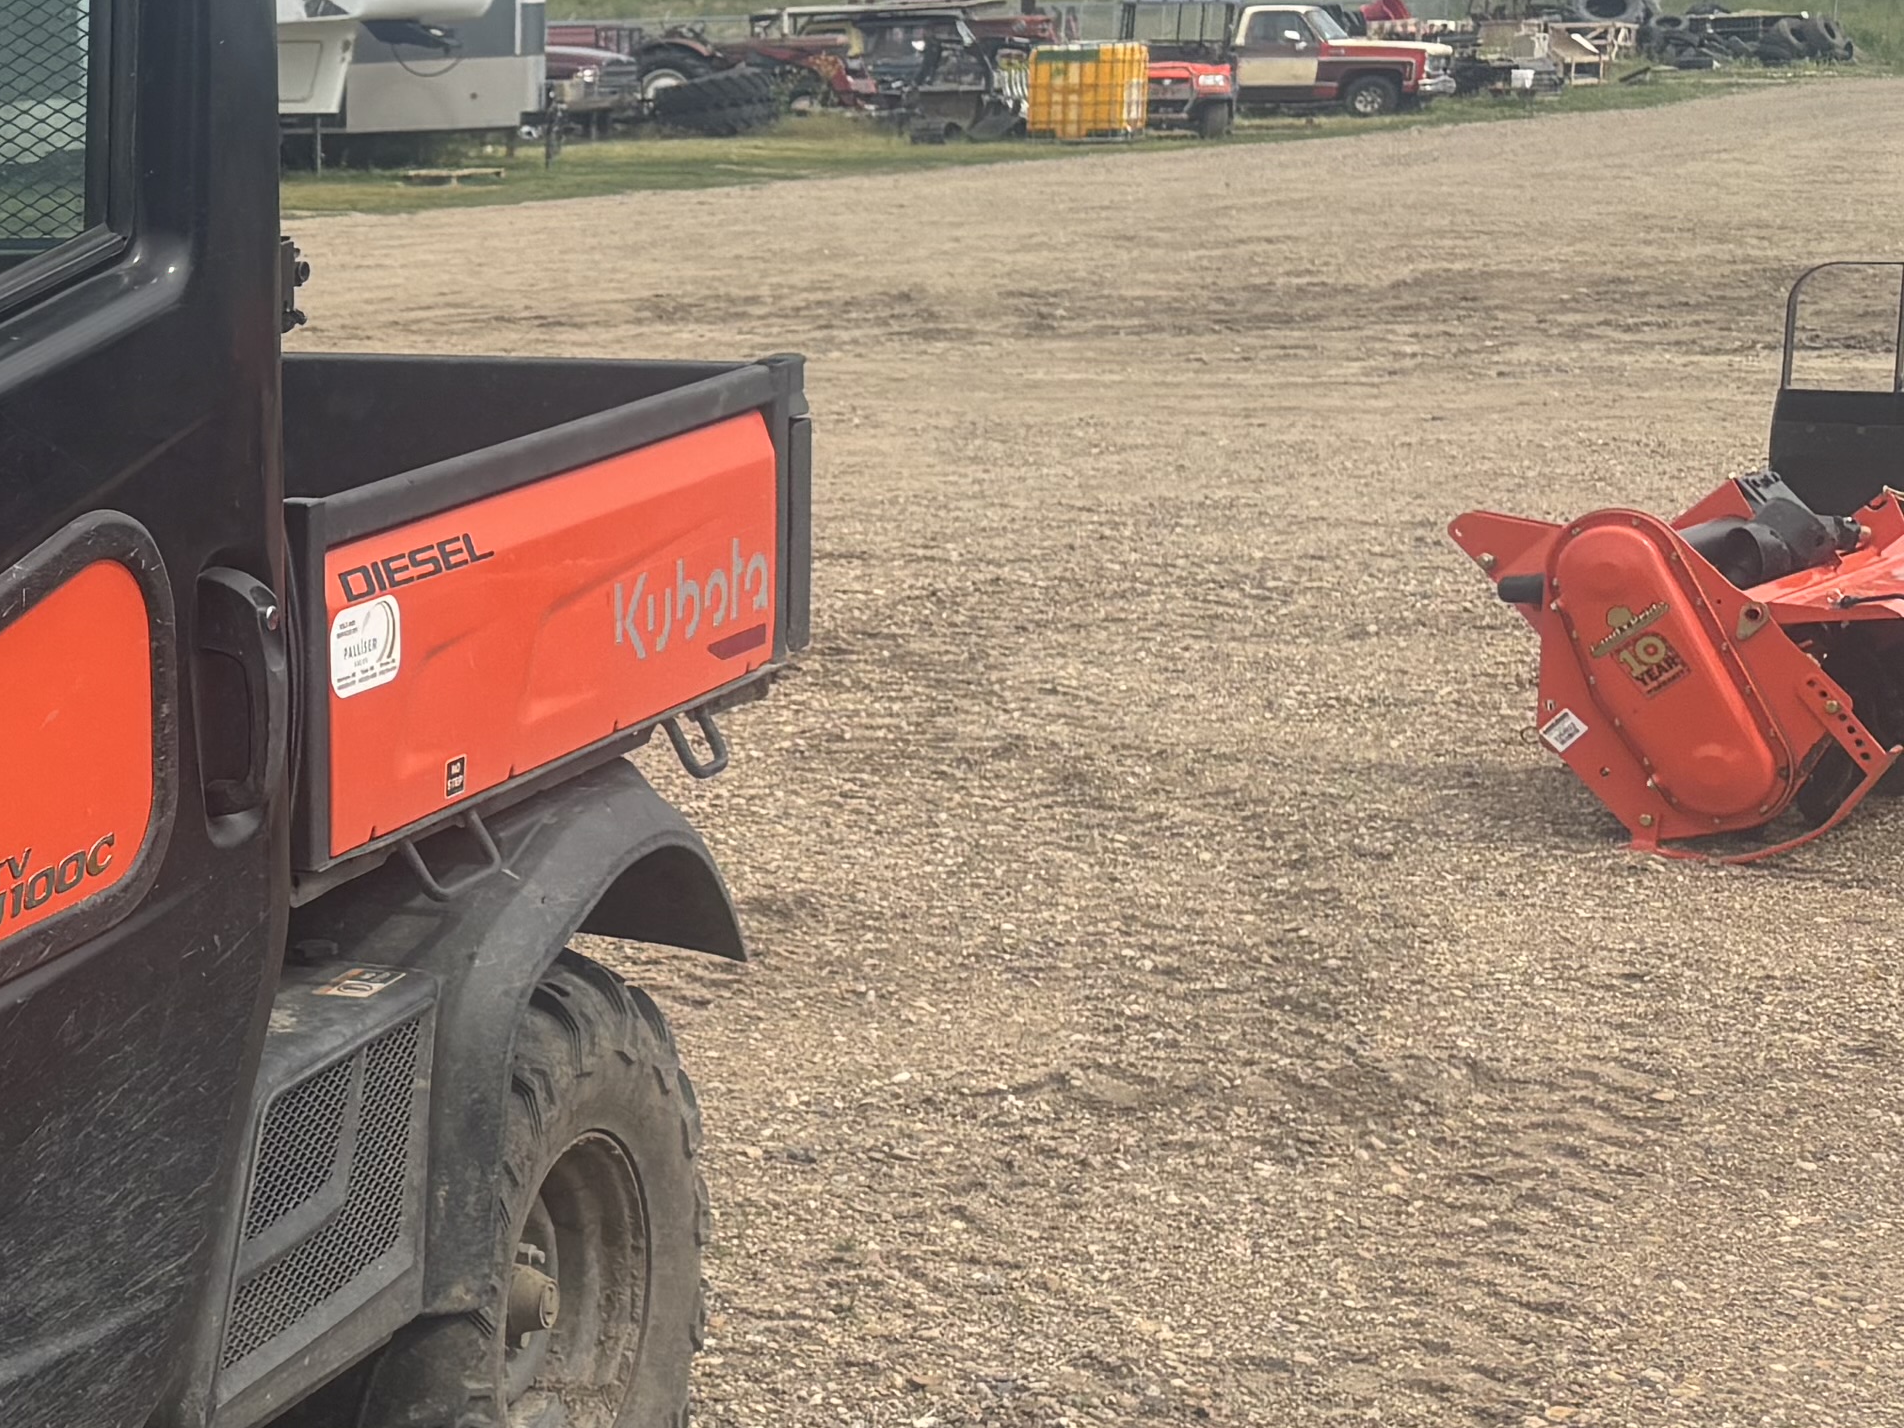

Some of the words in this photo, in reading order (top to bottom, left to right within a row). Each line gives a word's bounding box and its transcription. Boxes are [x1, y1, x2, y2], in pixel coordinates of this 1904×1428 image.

[338, 533, 494, 602] DIESEL
[614, 537, 769, 660] Kubota
[1619, 636, 1667, 678] 10
[1633, 652, 1682, 686] YEAR
